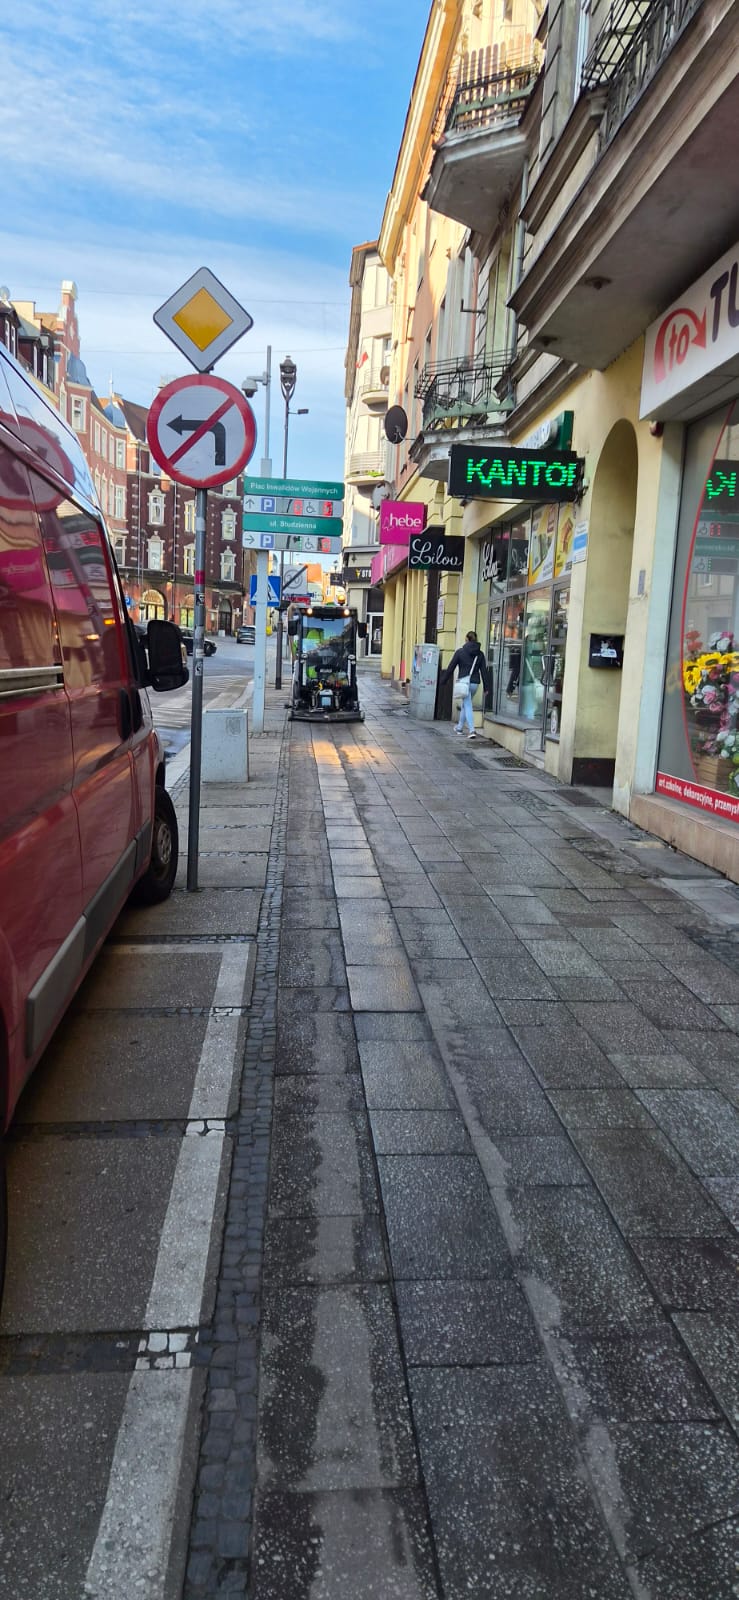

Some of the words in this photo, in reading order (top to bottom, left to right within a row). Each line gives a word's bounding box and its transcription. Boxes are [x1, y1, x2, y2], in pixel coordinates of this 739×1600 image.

[668, 322, 690, 372] to
[250, 482, 265, 490] Plac
[266, 483, 300, 492] Inwalidów
[301, 486, 338, 496] Wojennych
[269, 520, 278, 528] ul.
[280, 521, 317, 529] Studzienna
[389, 513, 422, 528] hebe
[410, 538, 462, 567] Lilou
